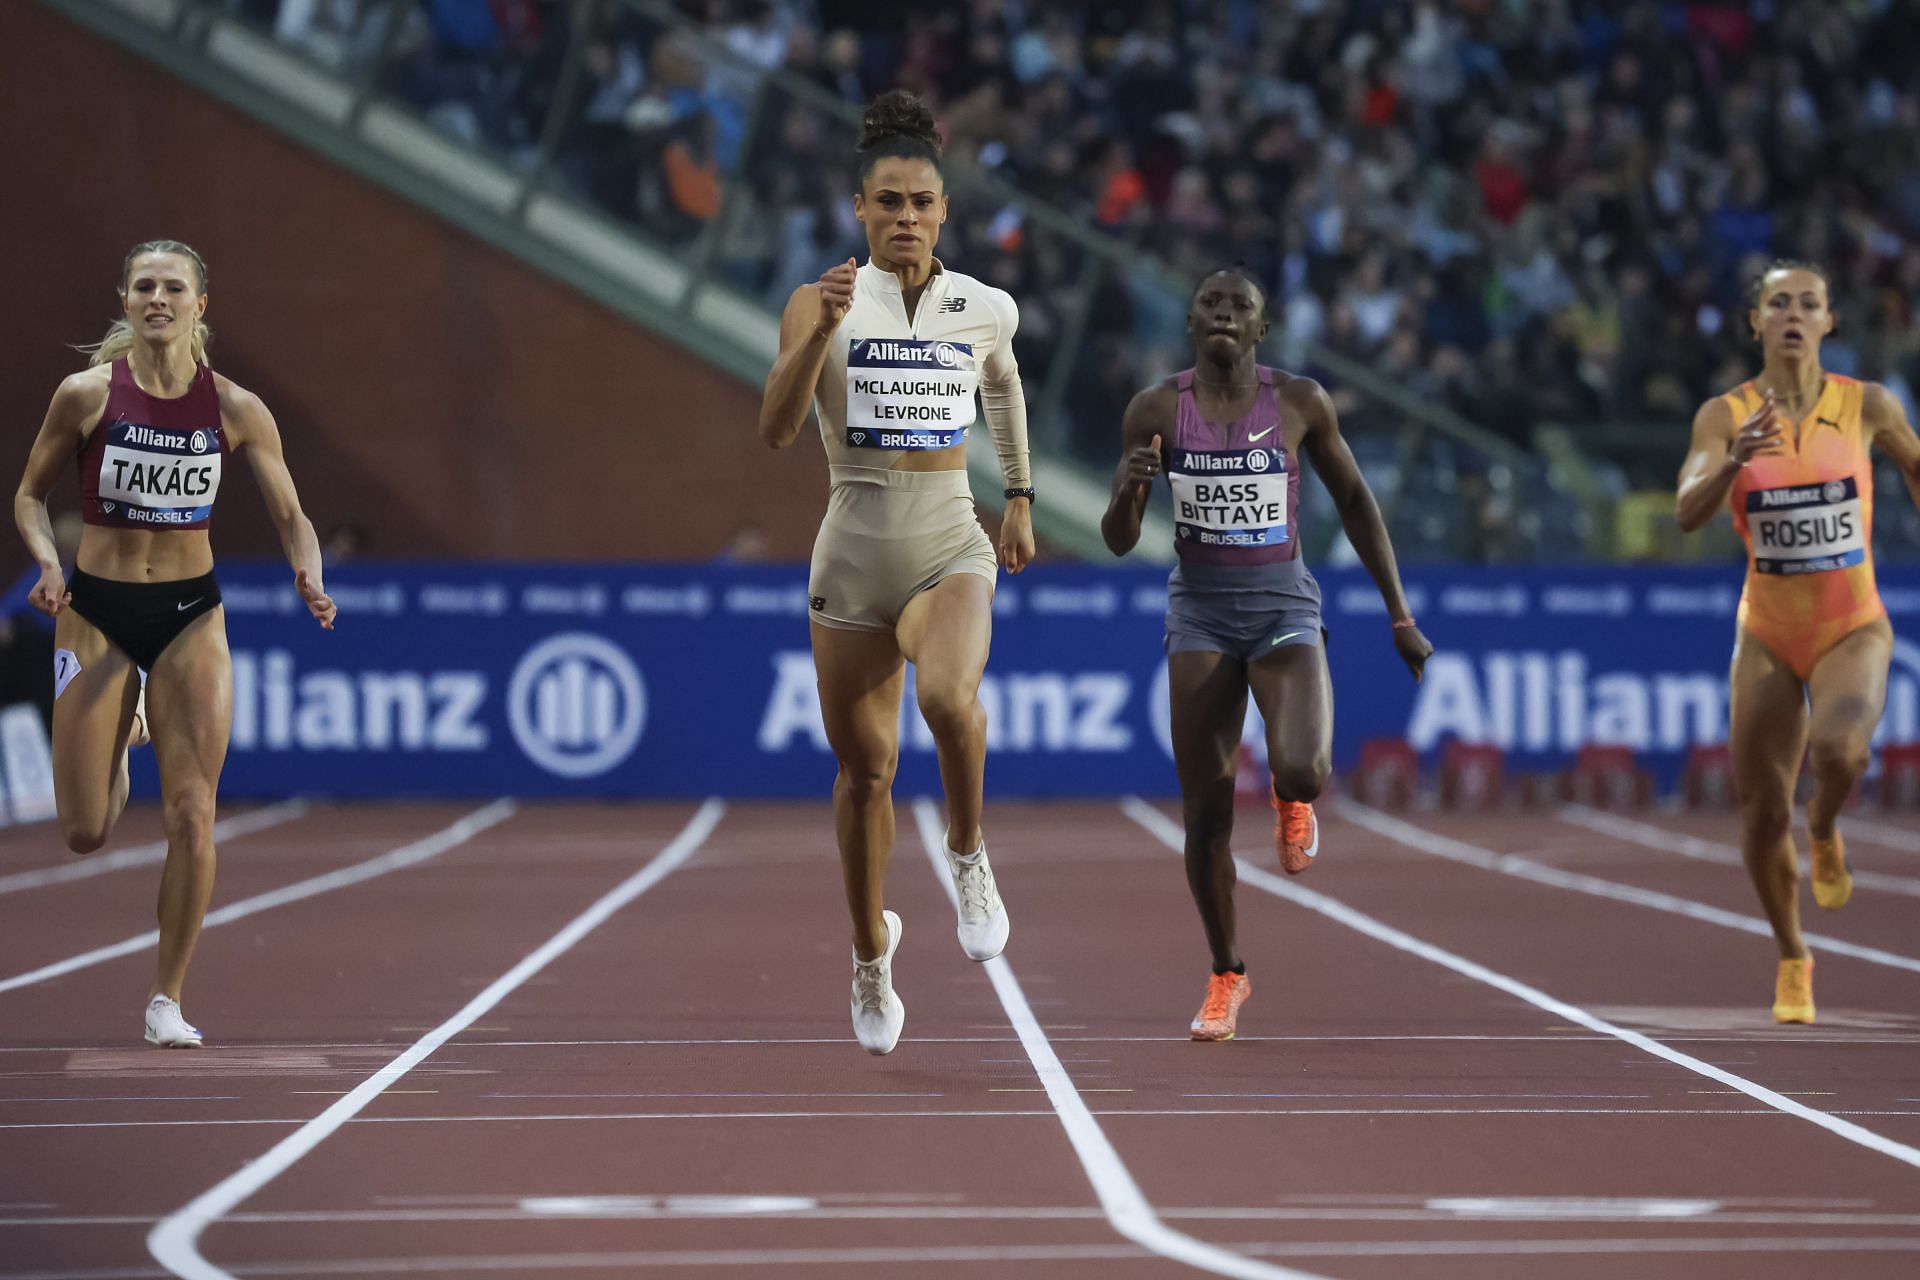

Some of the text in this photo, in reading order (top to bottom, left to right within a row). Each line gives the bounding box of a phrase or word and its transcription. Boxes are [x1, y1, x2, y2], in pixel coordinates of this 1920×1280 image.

[866, 342, 933, 362] Allianz
[854, 379, 967, 397] MCLAUGHLIN-
[874, 405, 952, 421] LEVRONE
[123, 425, 186, 450] Allianz
[881, 433, 951, 448] BRUSSELS
[1183, 453, 1244, 470] Allianz
[112, 459, 212, 497] TAKÁCS
[1195, 483, 1259, 503] BASS
[1761, 487, 1821, 507] Allianz
[127, 507, 193, 524] BRUSSELS
[1180, 501, 1280, 524] BITTAYE
[1200, 532, 1266, 545] BRUSSELS
[1760, 511, 1854, 548] ROSIUS
[229, 649, 489, 749] lianz
[1404, 650, 1742, 752] Allian
